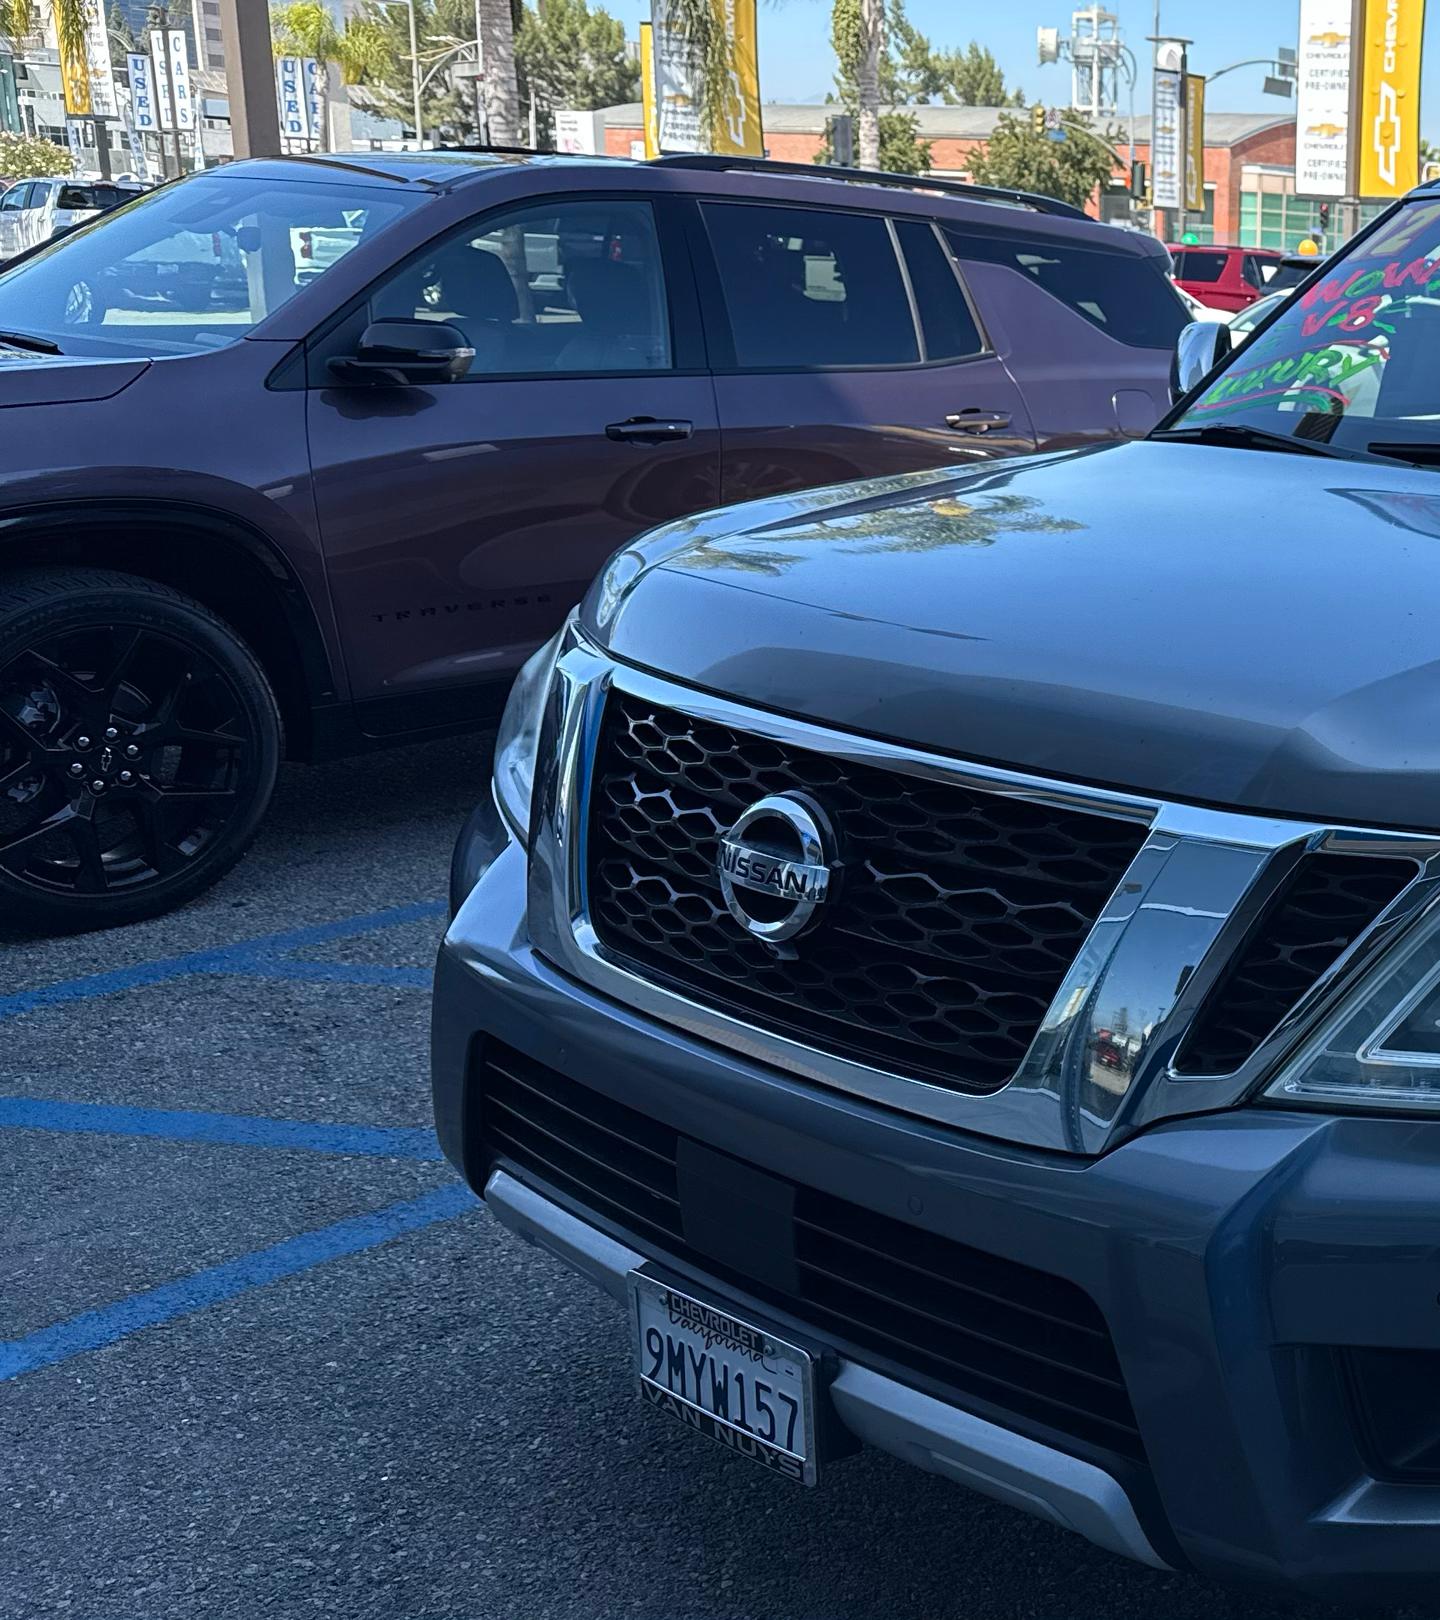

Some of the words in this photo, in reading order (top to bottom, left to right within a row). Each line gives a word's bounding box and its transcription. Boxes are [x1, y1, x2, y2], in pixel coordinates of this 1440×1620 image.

[132, 59, 152, 126] USED
[173, 37, 189, 123] CARS
[283, 60, 302, 132] USED
[371, 594, 550, 622] TRAVERSE
[720, 846, 808, 894] NISSAN
[671, 1294, 758, 1348] CHEVROLET
[646, 1327, 798, 1450] 9MYW157
[642, 1381, 700, 1429] VAN
[713, 1421, 801, 1479] NUYS
